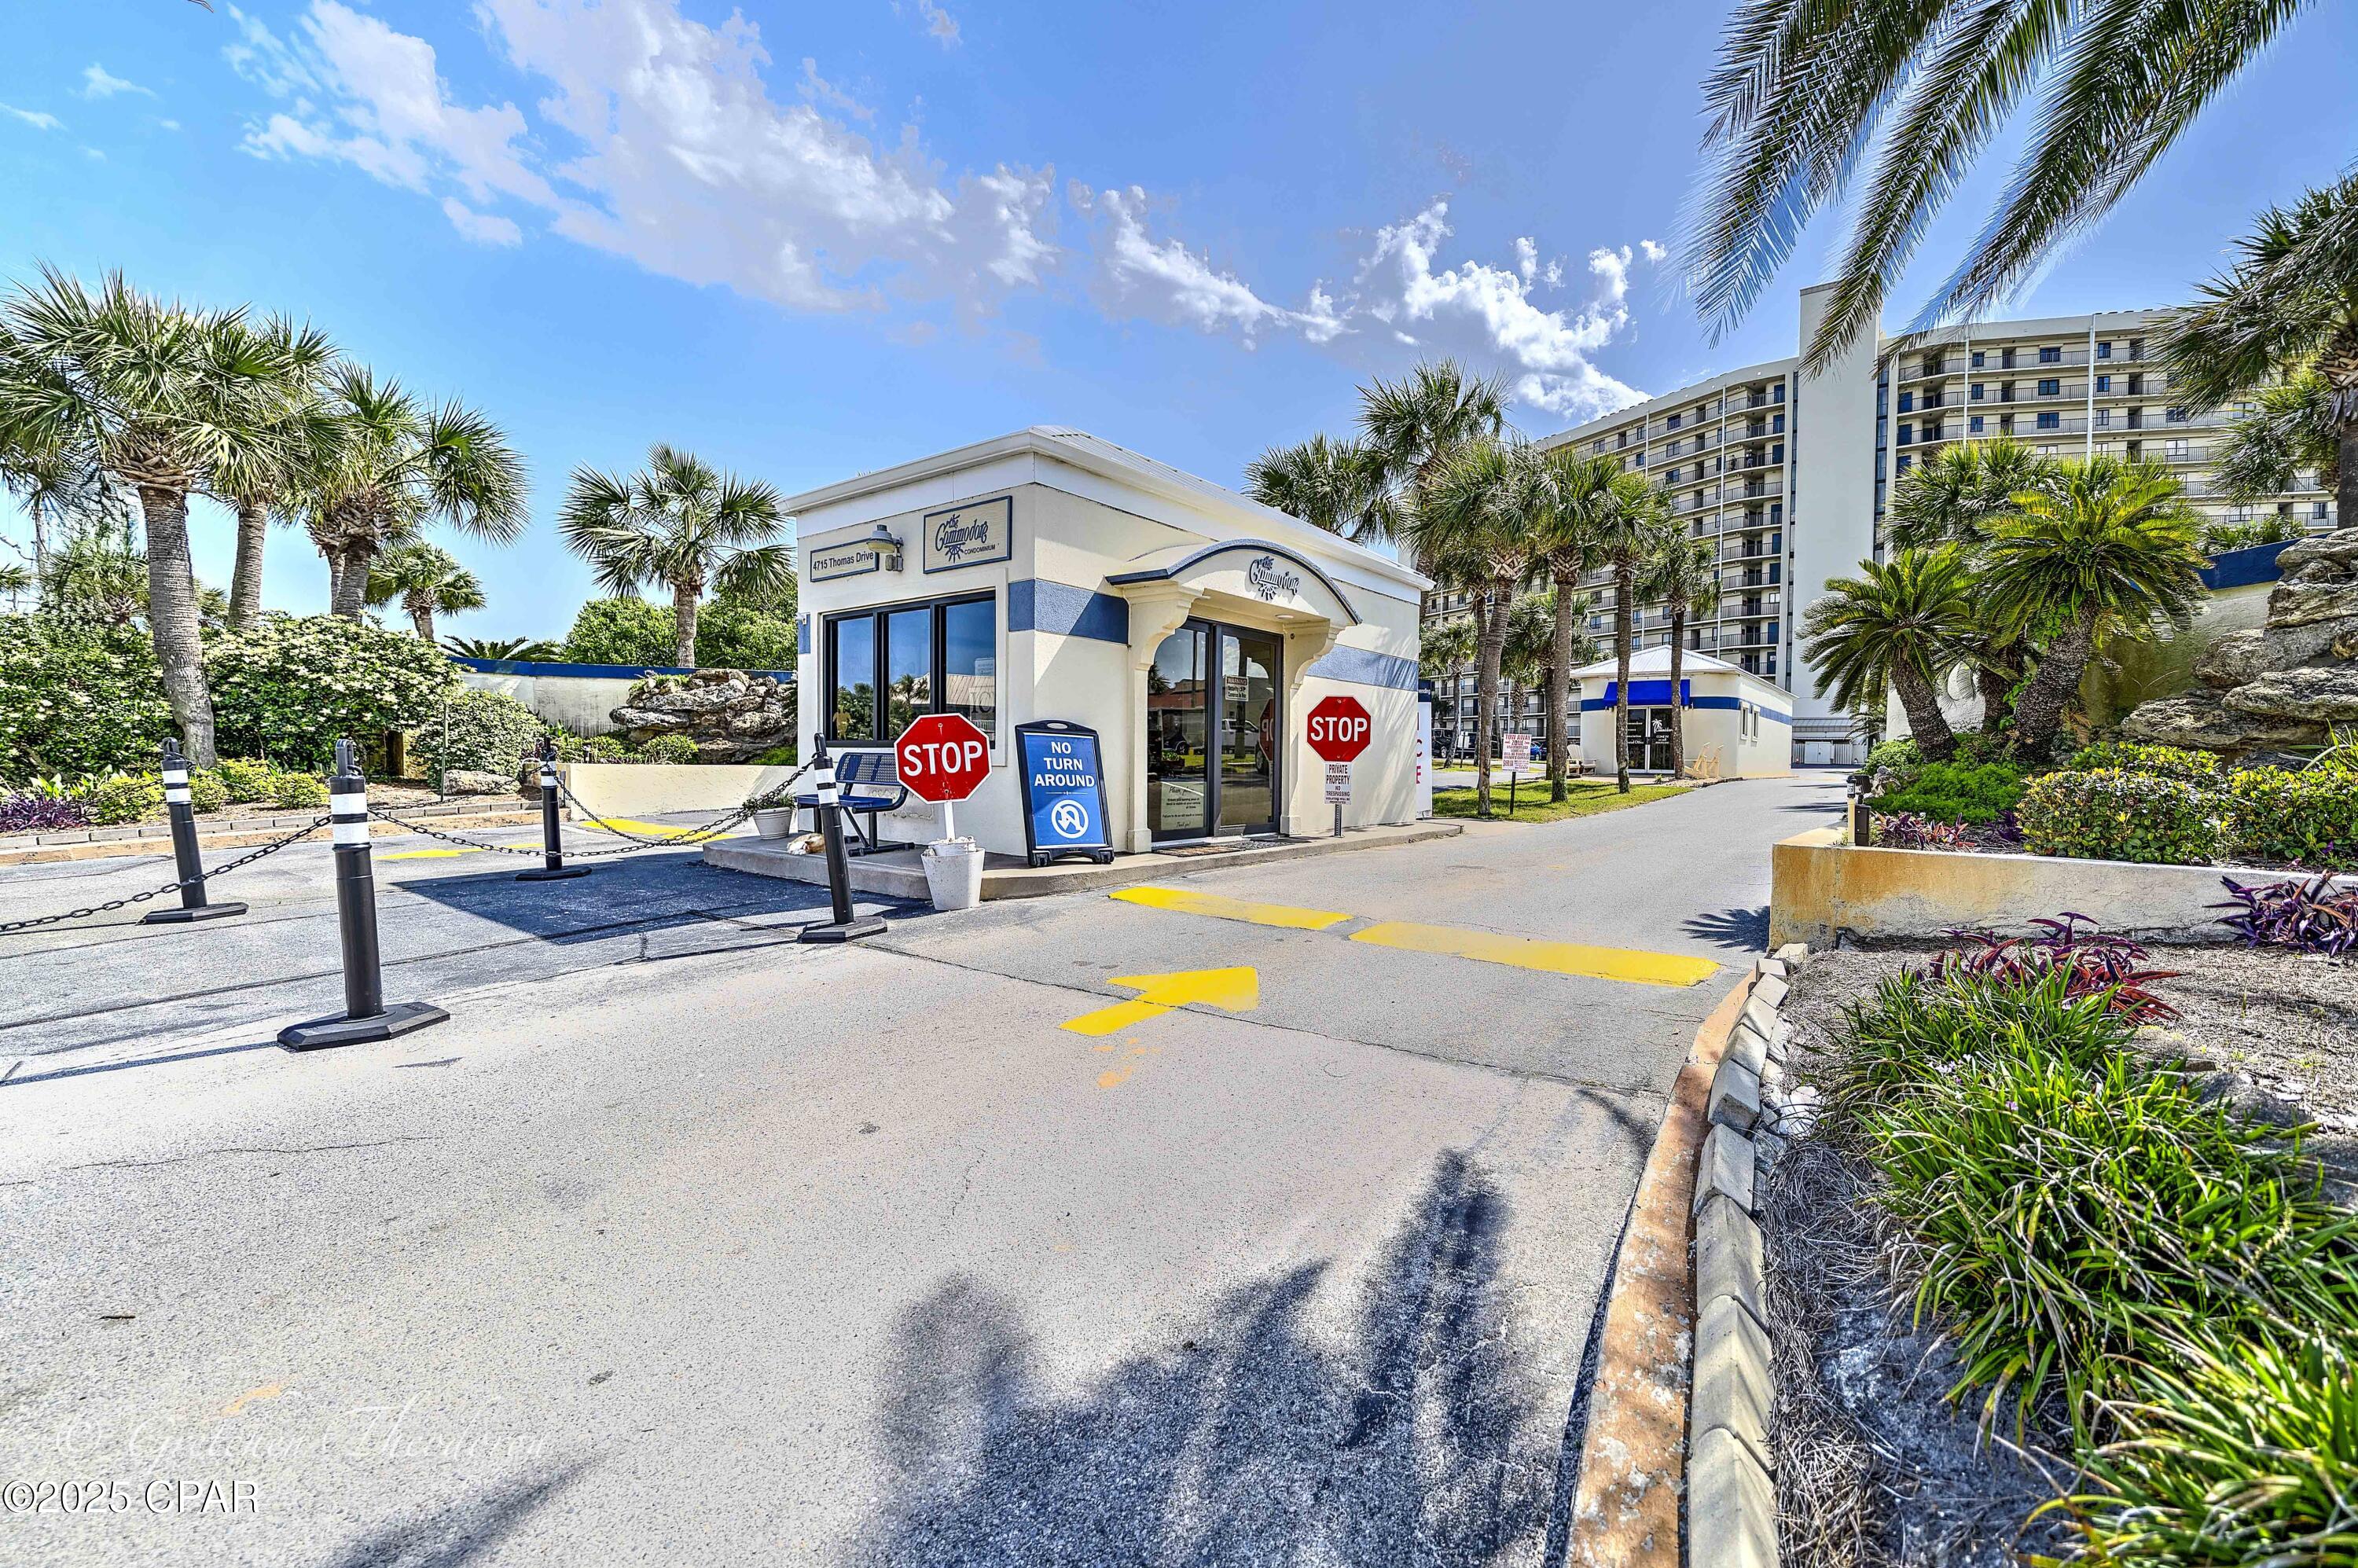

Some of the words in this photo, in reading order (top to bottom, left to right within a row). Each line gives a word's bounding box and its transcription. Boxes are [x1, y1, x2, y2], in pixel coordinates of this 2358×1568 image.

[935, 519, 989, 552] Commodore
[964, 545, 996, 554] CONDOMINIUM
[813, 560, 828, 571] 4715
[829, 556, 854, 567] Thomas
[856, 551, 873, 562] Drive
[1250, 560, 1299, 595] Commodore
[970, 692, 994, 713] IC
[1310, 716, 1368, 743] STOP
[1051, 741, 1072, 755] NO
[903, 740, 983, 777] STOP
[1043, 757, 1083, 771] TURN
[1328, 765, 1347, 774] PRIVATE
[1034, 773, 1095, 788] AROUND
[1326, 775, 1350, 784] PROPERTY
